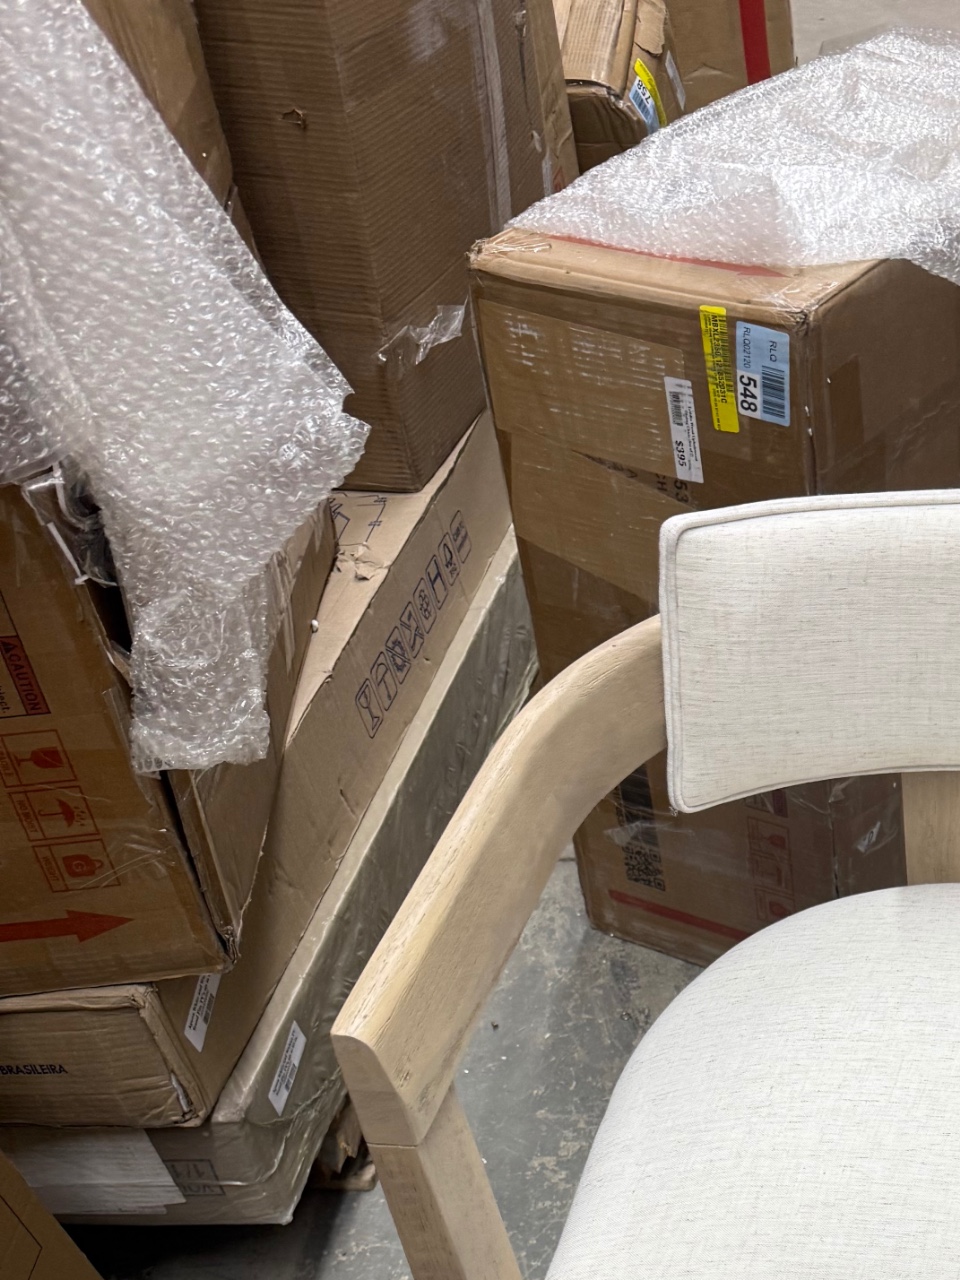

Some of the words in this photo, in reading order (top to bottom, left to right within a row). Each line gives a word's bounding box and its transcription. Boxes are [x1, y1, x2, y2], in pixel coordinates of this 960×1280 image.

[743, 326, 751, 369] RLQ02120
[739, 374, 758, 413] 548
[675, 440, 687, 467] $395
[10, 654, 41, 711] CAUTION
[0, 1064, 68, 1075] BRASILEIRA
